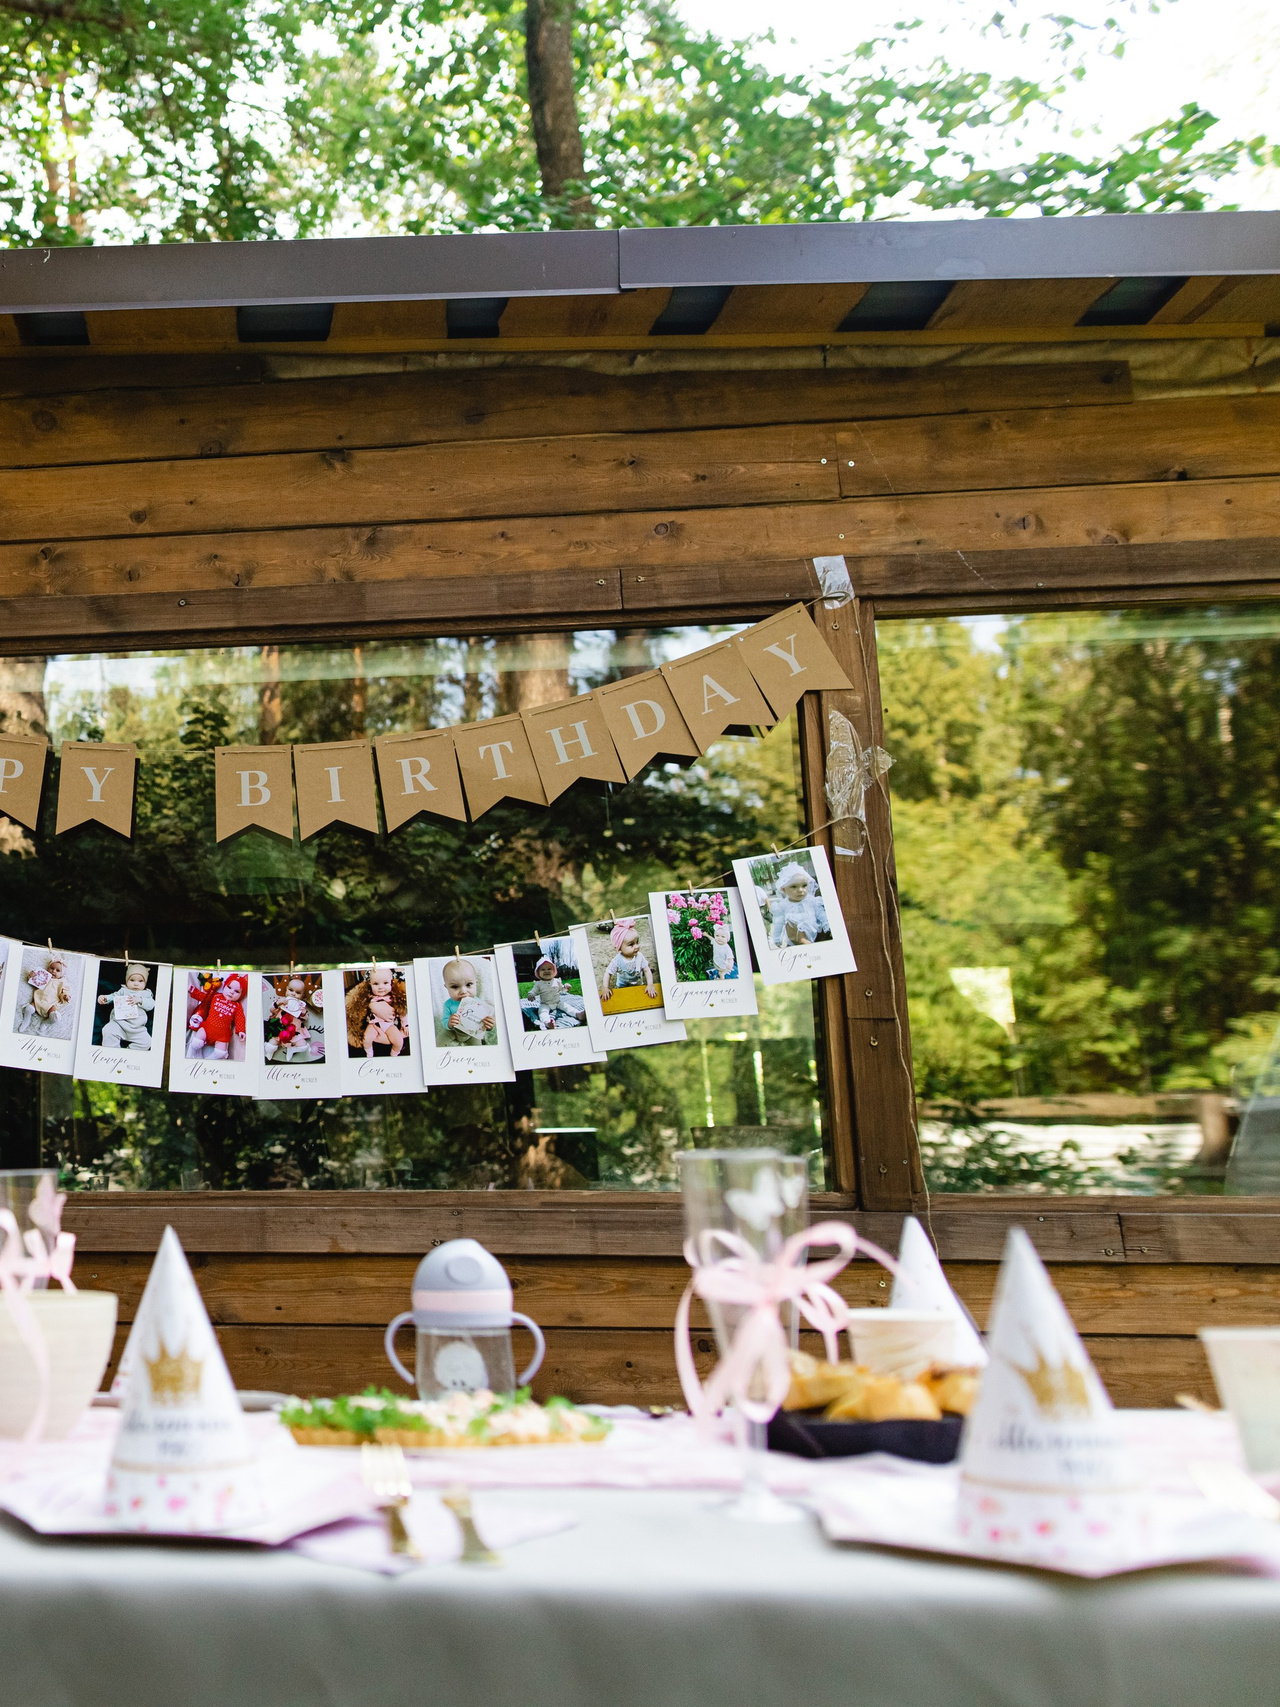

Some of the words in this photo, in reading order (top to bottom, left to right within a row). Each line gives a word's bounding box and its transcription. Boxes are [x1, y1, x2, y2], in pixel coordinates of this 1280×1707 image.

[236, 634, 807, 807] BIRTHDAY
[670, 984, 735, 1008] Одиннадцать
[604, 1016, 645, 1033] Десять
[644, 1023, 662, 1031] МЕСЯЦЕВ
[18, 1038, 48, 1061] Три
[522, 1033, 565, 1051] Девять
[89, 1048, 128, 1073] Четыре
[358, 1059, 385, 1078] Семь
[436, 1050, 475, 1069] Восемь
[185, 1061, 219, 1082] Пять
[265, 1065, 301, 1082] Шесть
